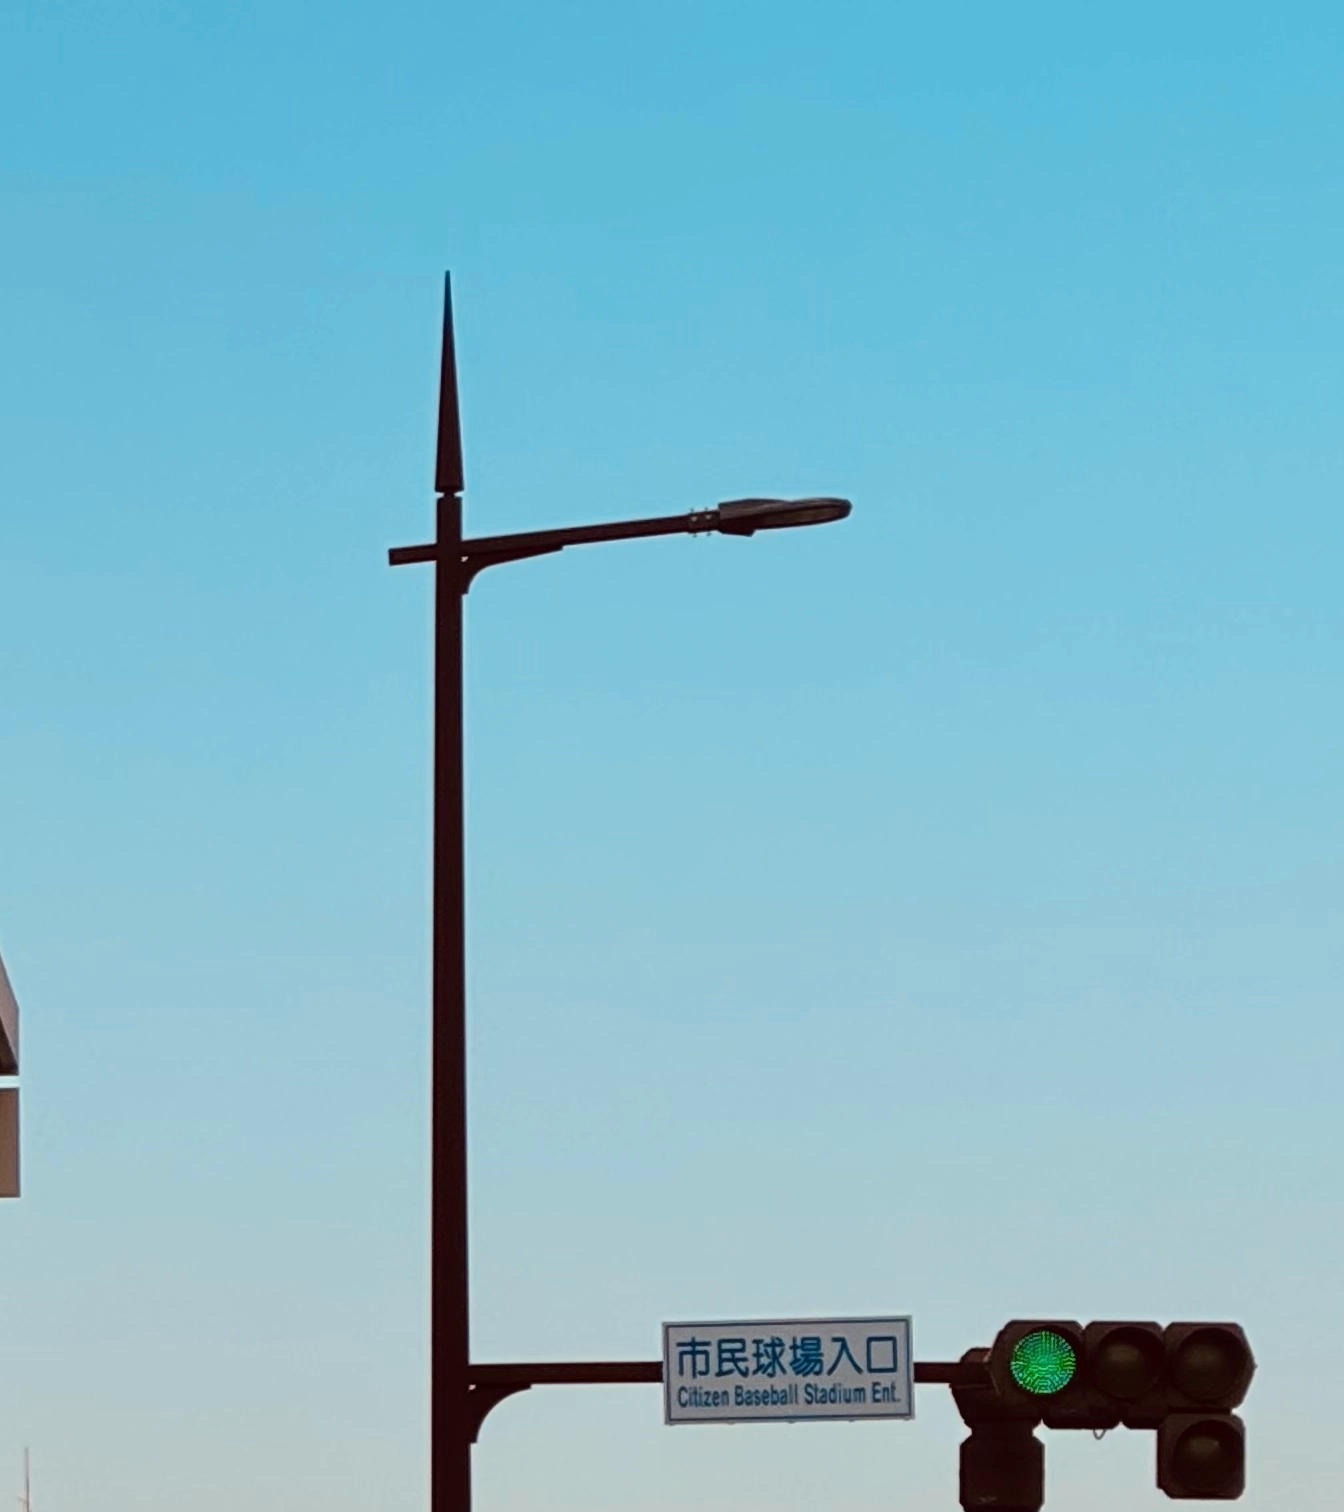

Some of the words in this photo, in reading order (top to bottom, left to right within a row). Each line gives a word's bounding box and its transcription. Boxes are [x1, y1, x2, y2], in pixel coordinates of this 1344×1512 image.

[676, 1336, 898, 1378] 市民球場入口
[678, 1386, 729, 1408] Citizen
[734, 1383, 798, 1407] Baseball
[804, 1382, 866, 1405] Stadium
